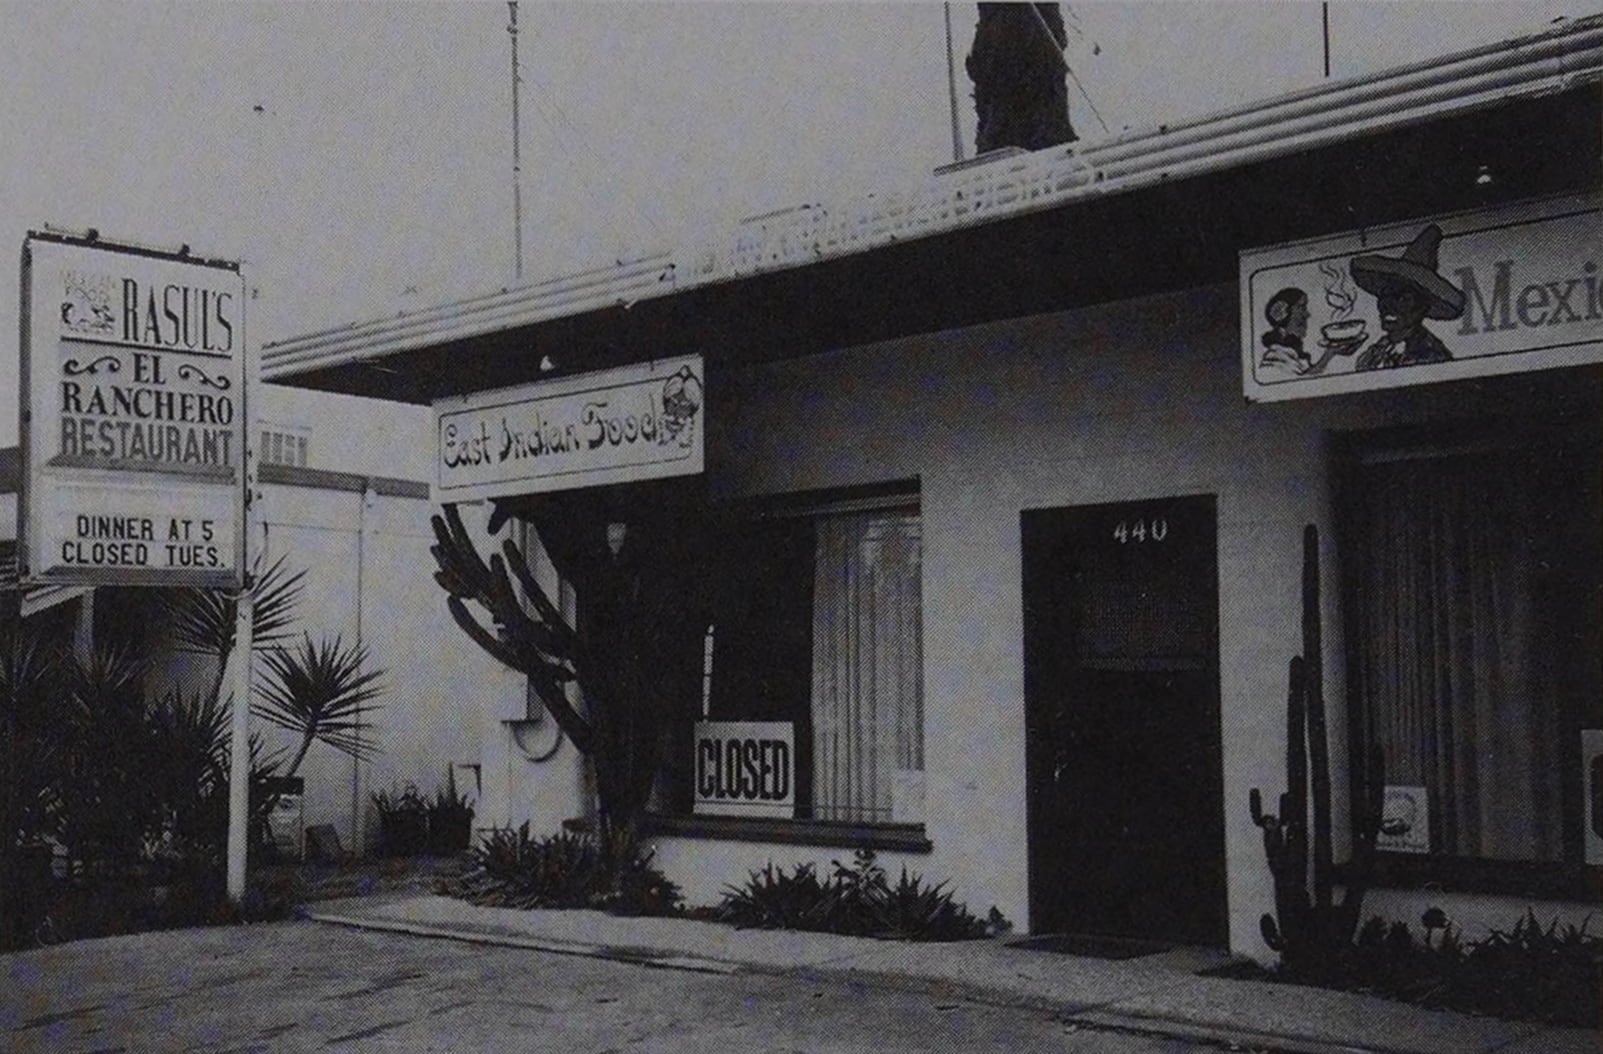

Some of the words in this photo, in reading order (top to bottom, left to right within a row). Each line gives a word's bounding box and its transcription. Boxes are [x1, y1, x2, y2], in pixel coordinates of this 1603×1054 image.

[122, 278, 233, 352] RASUL'S
[1454, 259, 1603, 336] Mexi
[134, 353, 166, 384] EL
[62, 381, 234, 425] RANCHERO
[62, 417, 234, 466] RESTAURANT
[444, 421, 492, 468] East
[499, 412, 580, 462] Indian
[581, 394, 657, 450] Food
[77, 515, 154, 541] DINNER
[168, 519, 196, 541] AT
[202, 521, 214, 541] 5
[1113, 519, 1168, 544] 440
[62, 541, 148, 567] CLOSED
[165, 545, 226, 568] TUES.
[699, 738, 789, 801] CLOSED
